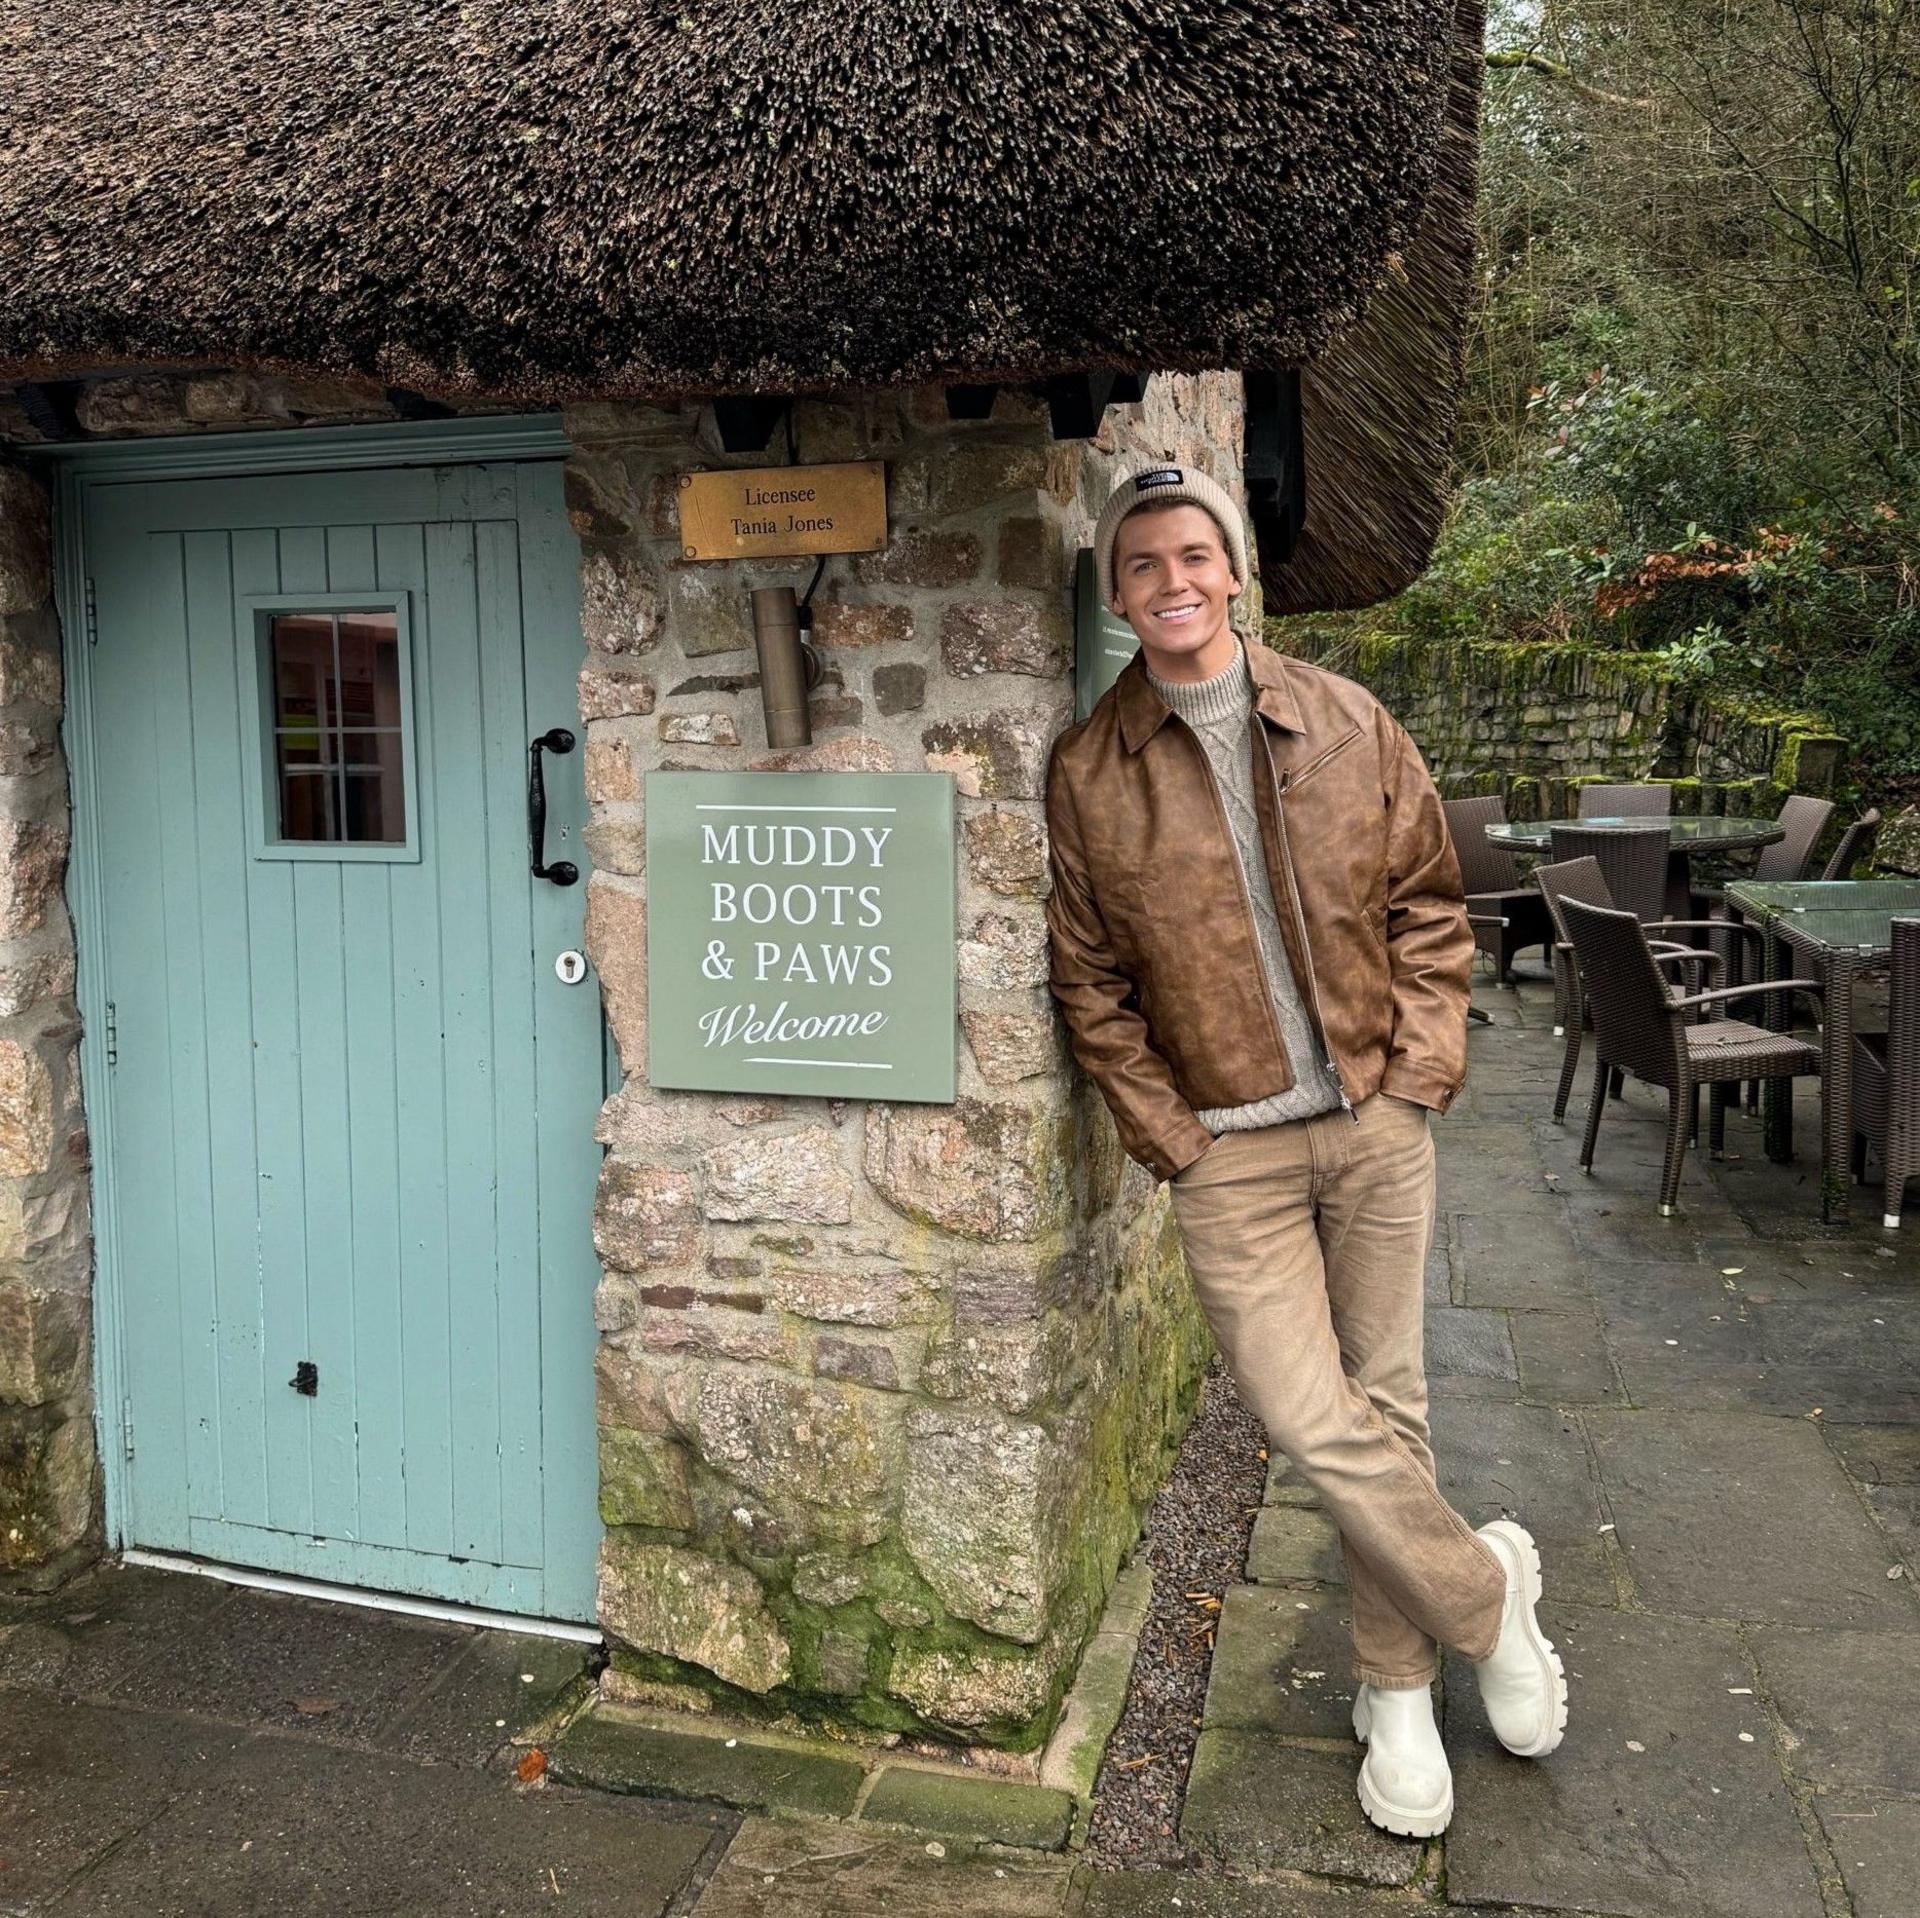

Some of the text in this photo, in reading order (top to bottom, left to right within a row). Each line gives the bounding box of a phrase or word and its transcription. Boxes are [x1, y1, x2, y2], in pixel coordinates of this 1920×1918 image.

[744, 488, 816, 506] Licensee
[731, 515, 834, 536] Tania Jones
[701, 824, 892, 867] MUDDY
[710, 882, 882, 928] BOOTS
[701, 939, 892, 987] & PAWS
[698, 1000, 889, 1048] Welcome
